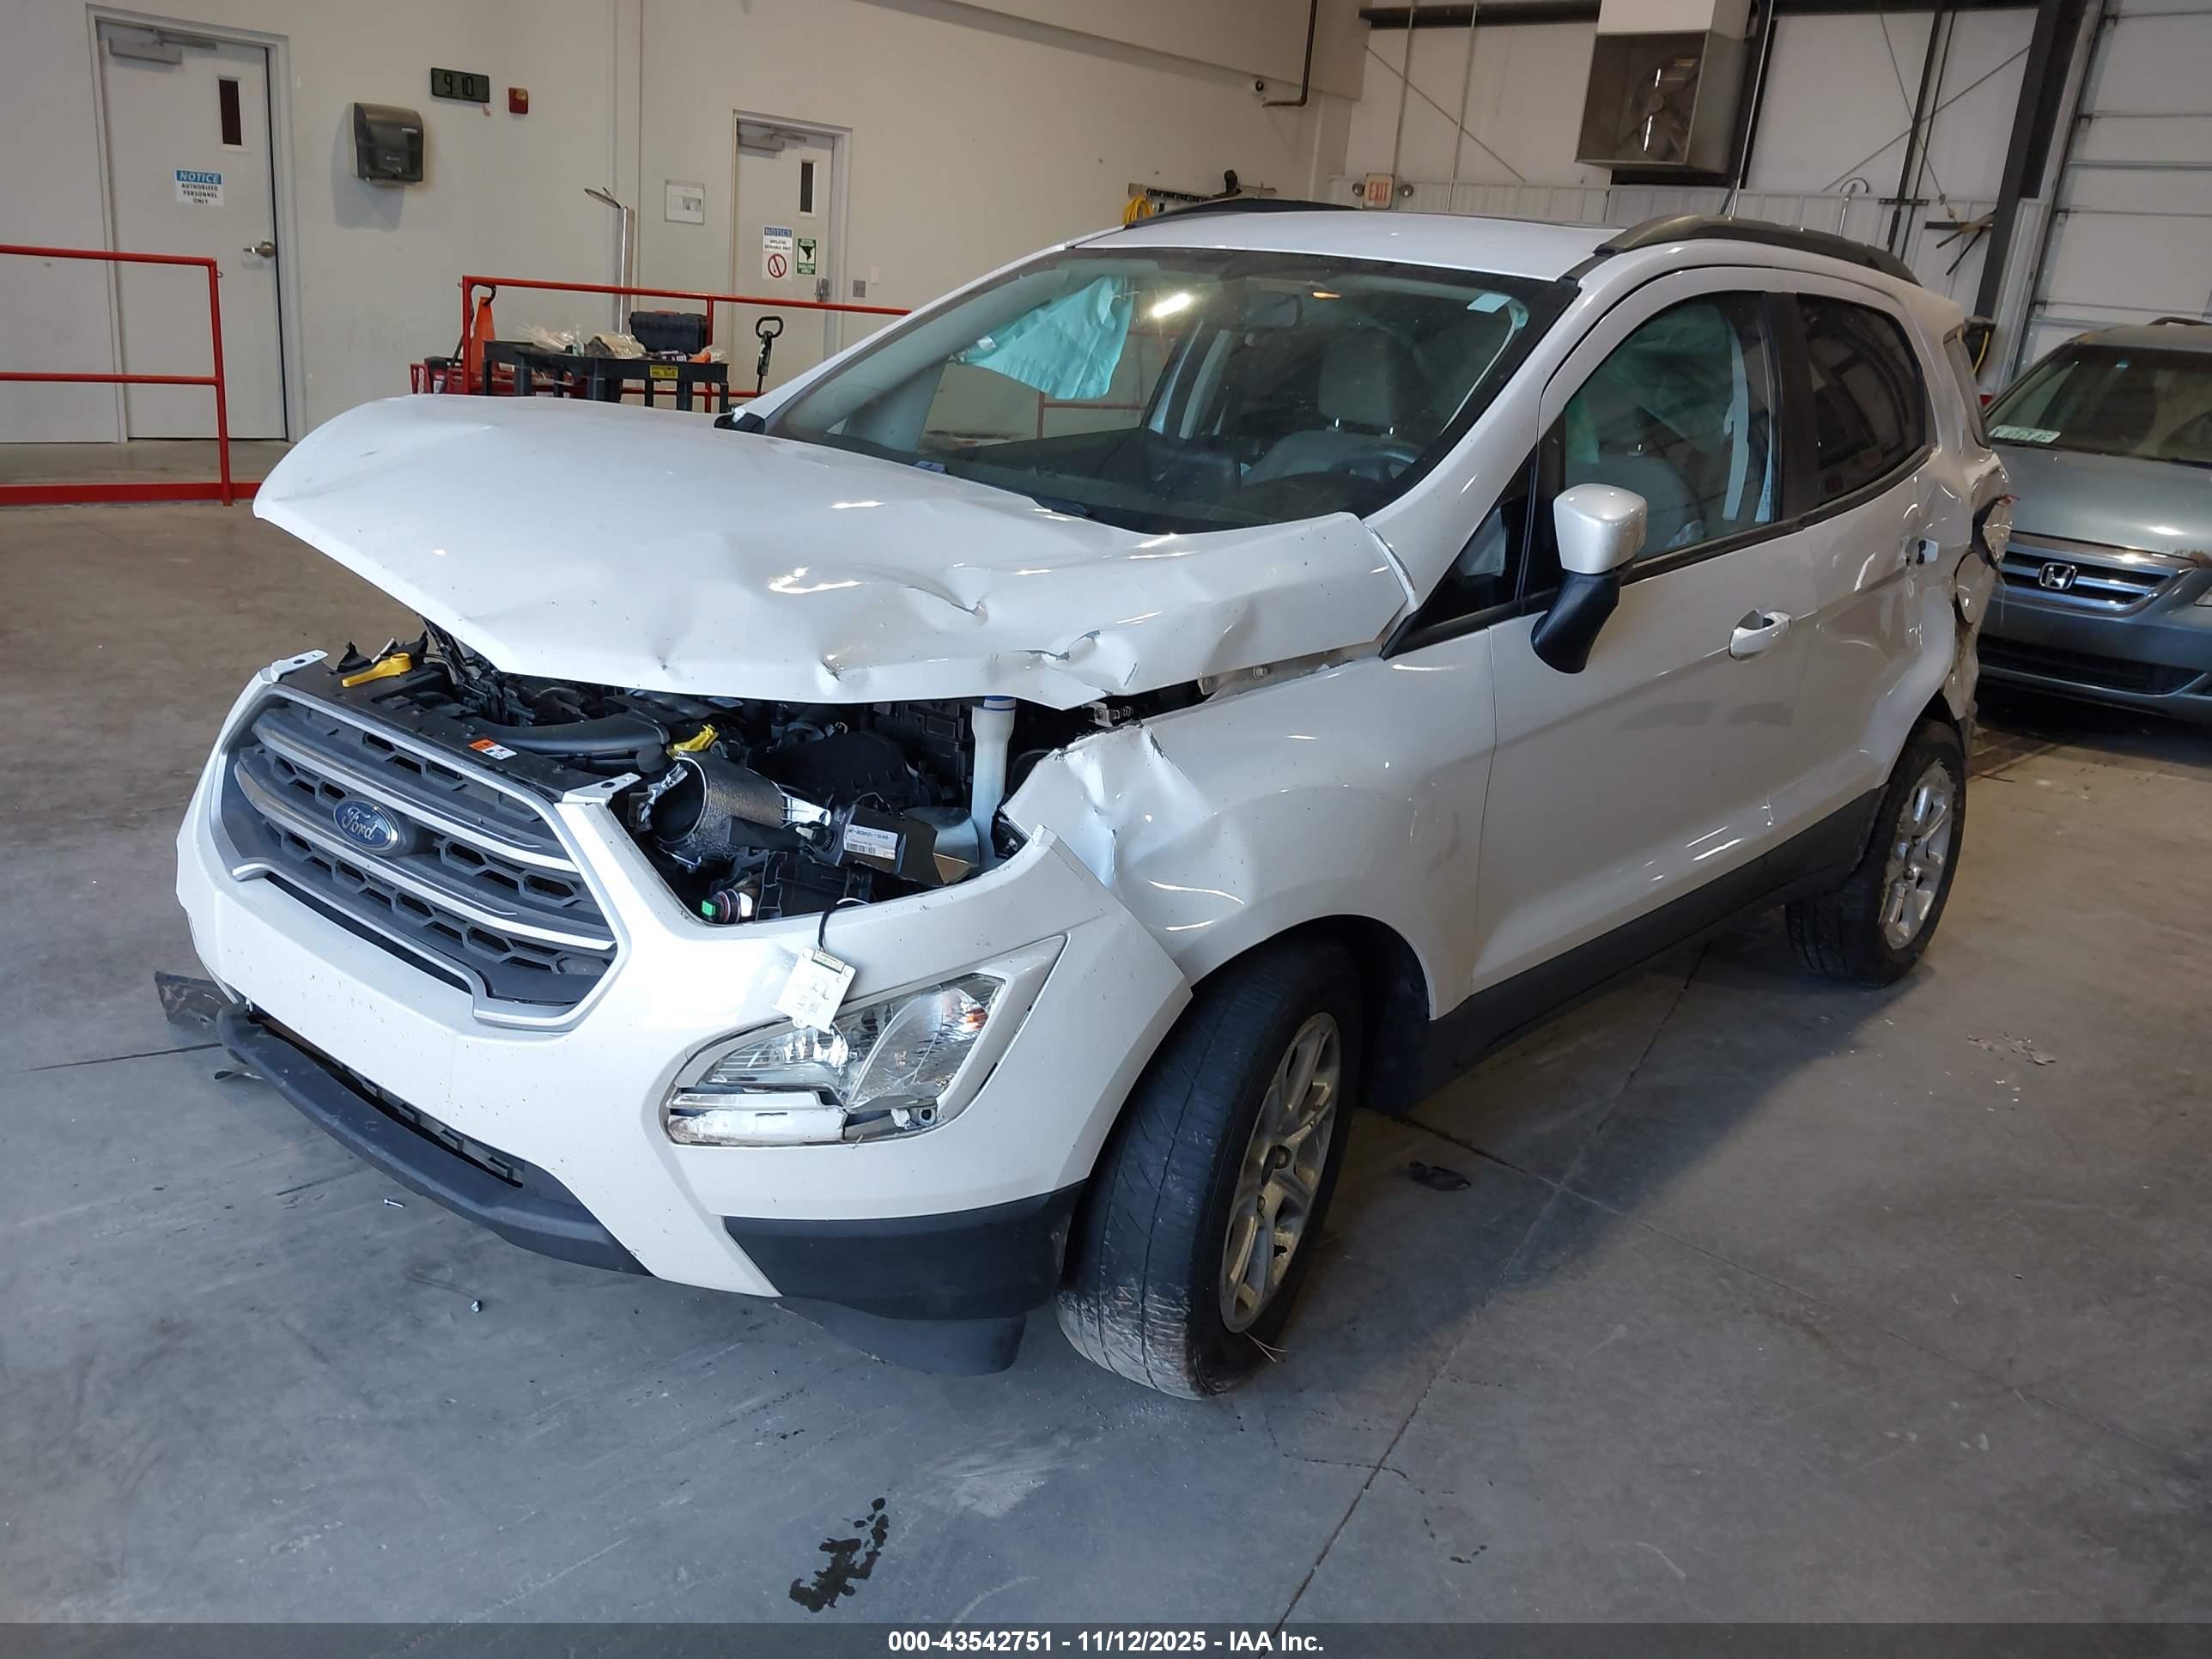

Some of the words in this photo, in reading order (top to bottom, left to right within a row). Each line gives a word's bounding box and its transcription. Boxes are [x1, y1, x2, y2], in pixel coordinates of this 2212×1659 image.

[179, 172, 220, 184] NOTICE
[181, 183, 218, 191] AUTHORIZED
[1368, 181, 1389, 201] EXIT
[183, 190, 217, 198] PERSONNEL
[765, 228, 791, 237] NOTICE
[342, 806, 379, 841] Ford
